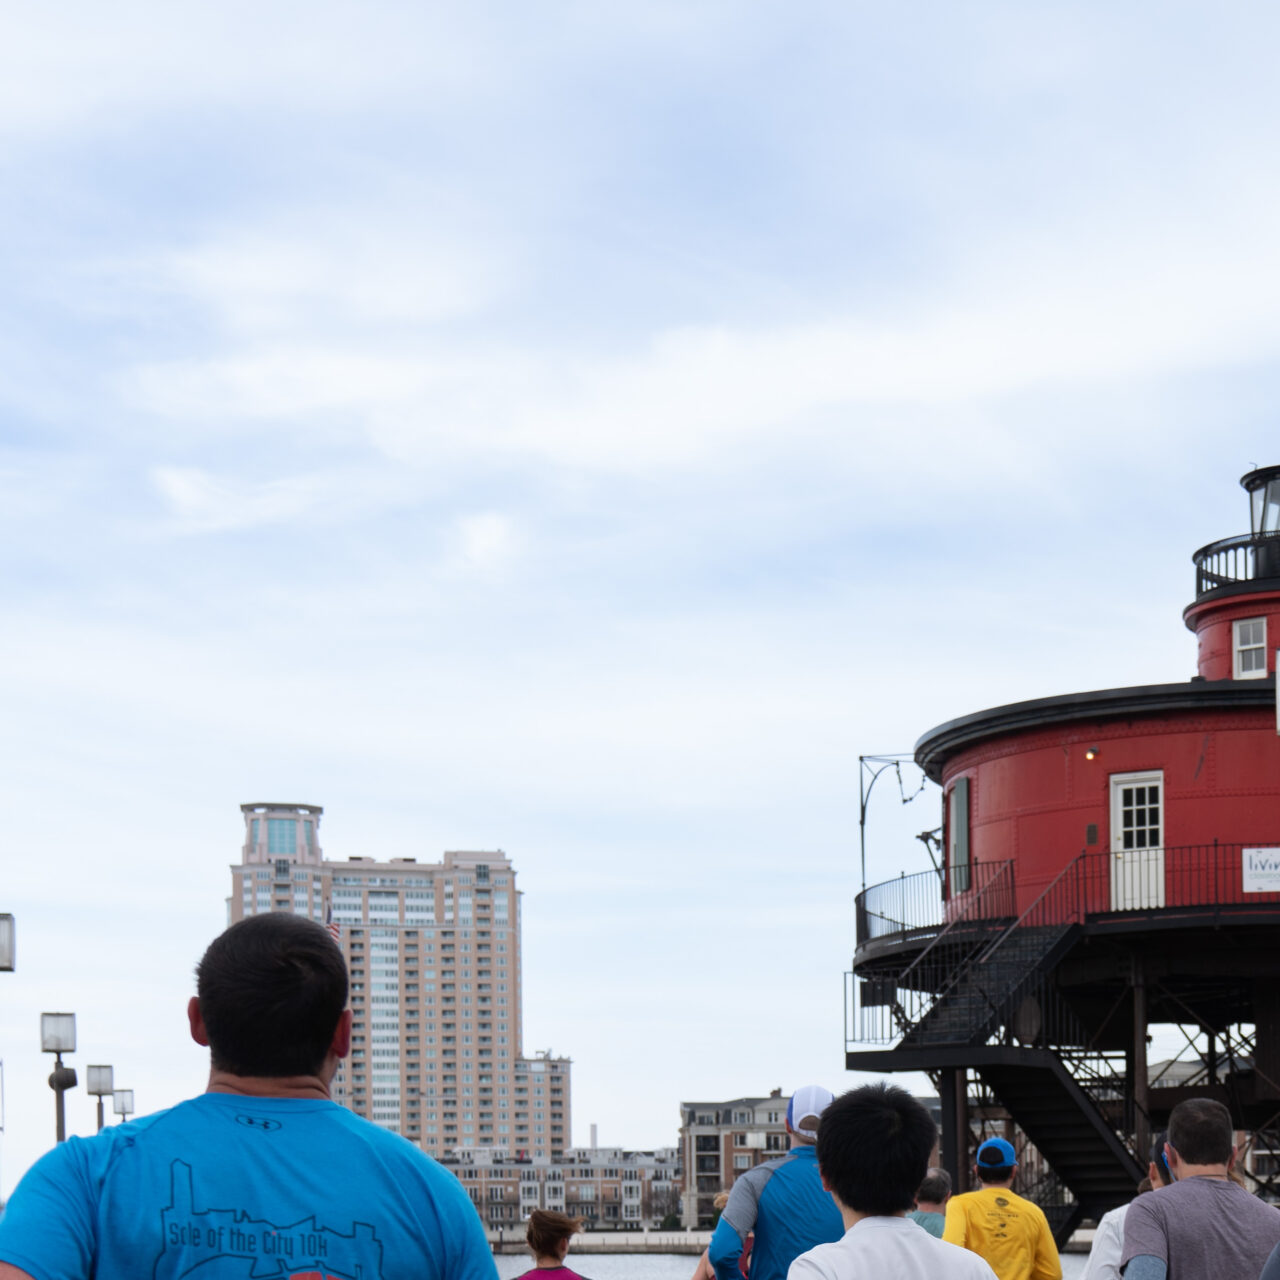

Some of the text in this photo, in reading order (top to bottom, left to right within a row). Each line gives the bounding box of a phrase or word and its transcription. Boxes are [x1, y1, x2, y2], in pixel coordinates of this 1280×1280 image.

[207, 1226, 225, 1253] of
[229, 1227, 257, 1254] the
[263, 1230, 294, 1259] City
